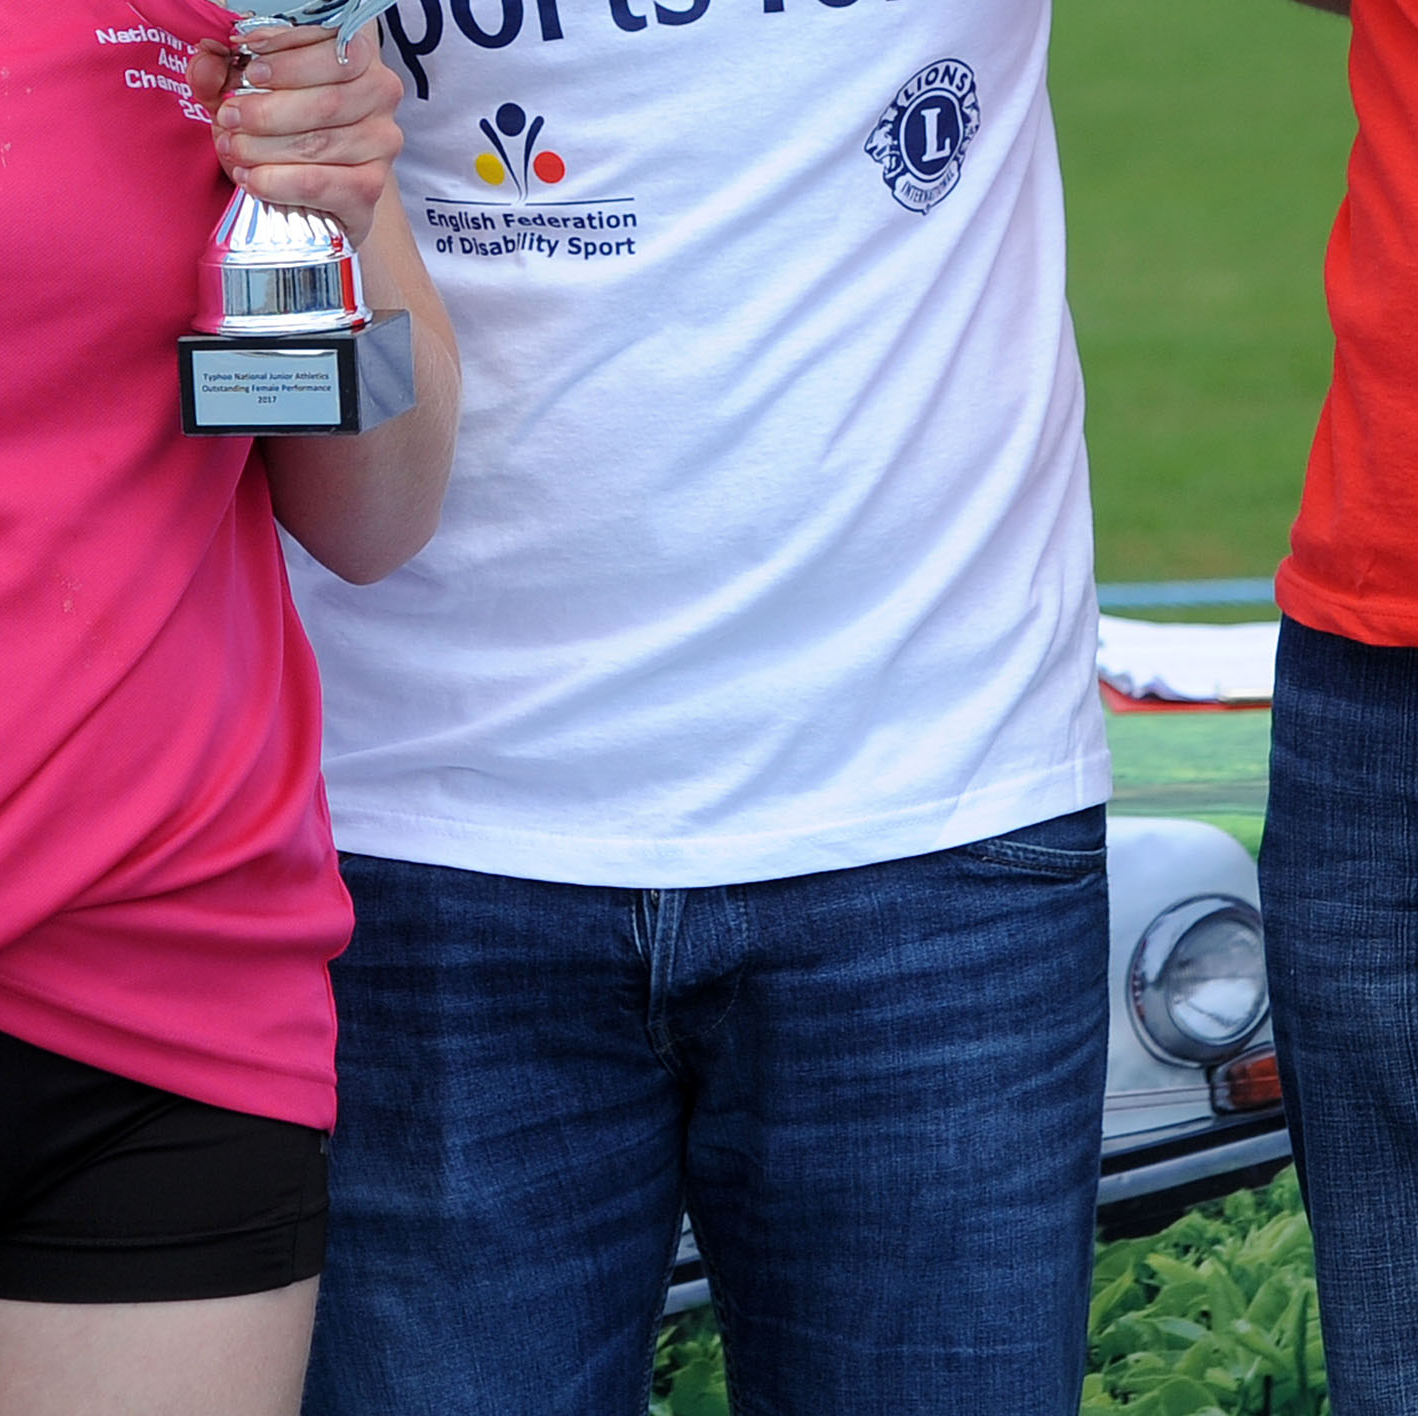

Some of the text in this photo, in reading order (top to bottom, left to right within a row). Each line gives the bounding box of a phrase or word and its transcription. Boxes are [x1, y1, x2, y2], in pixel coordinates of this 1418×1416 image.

[124, 69, 194, 100] Champ
[903, 64, 969, 102] LIONS
[178, 99, 213, 124] 20
[920, 107, 951, 163] L
[425, 208, 638, 233] English Federation
[435, 231, 636, 260] of Disability Sport
[201, 384, 332, 394] Outstanding Female Performance
[234, 372, 267, 381] National
[269, 372, 293, 381] Junior
[294, 372, 329, 381] Athletics
[257, 395, 277, 404] 2017
